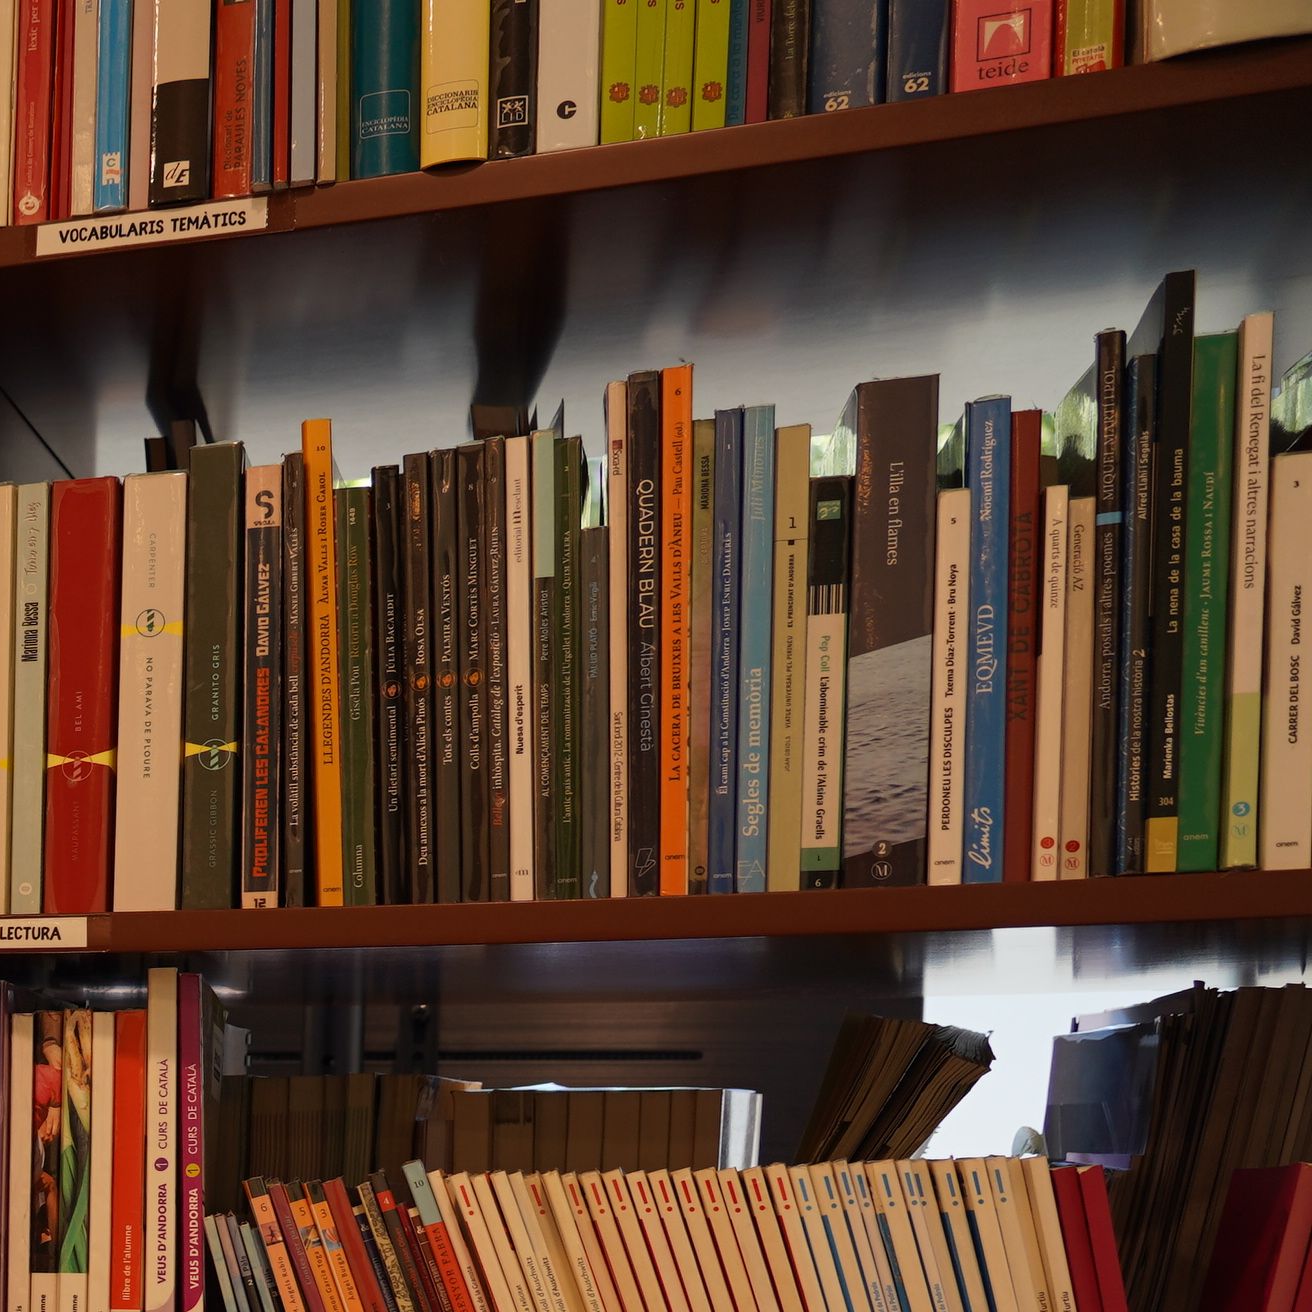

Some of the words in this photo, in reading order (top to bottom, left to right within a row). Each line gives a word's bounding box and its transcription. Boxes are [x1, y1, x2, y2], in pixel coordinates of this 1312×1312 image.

[979, 60, 1028, 81] teide
[59, 219, 164, 244] VOCABULARIS
[171, 209, 247, 233] TEMÀTICS
[889, 462, 904, 494] L'illa
[636, 479, 655, 573] QUADERN
[888, 498, 899, 515] en
[886, 520, 903, 566] flames
[257, 562, 270, 614] GÁLVEZ
[638, 578, 655, 628] BLAU
[256, 617, 269, 657] DAVID
[639, 641, 656, 689] Albert
[639, 693, 655, 752] Ginestà
[255, 758, 268, 783] LES
[253, 787, 268, 878] PROLIFEREN
[0, 926, 61, 942] LECTURA
[156, 1183, 167, 1250] D'ANDORRA
[432, 1226, 451, 1266] FABRA
